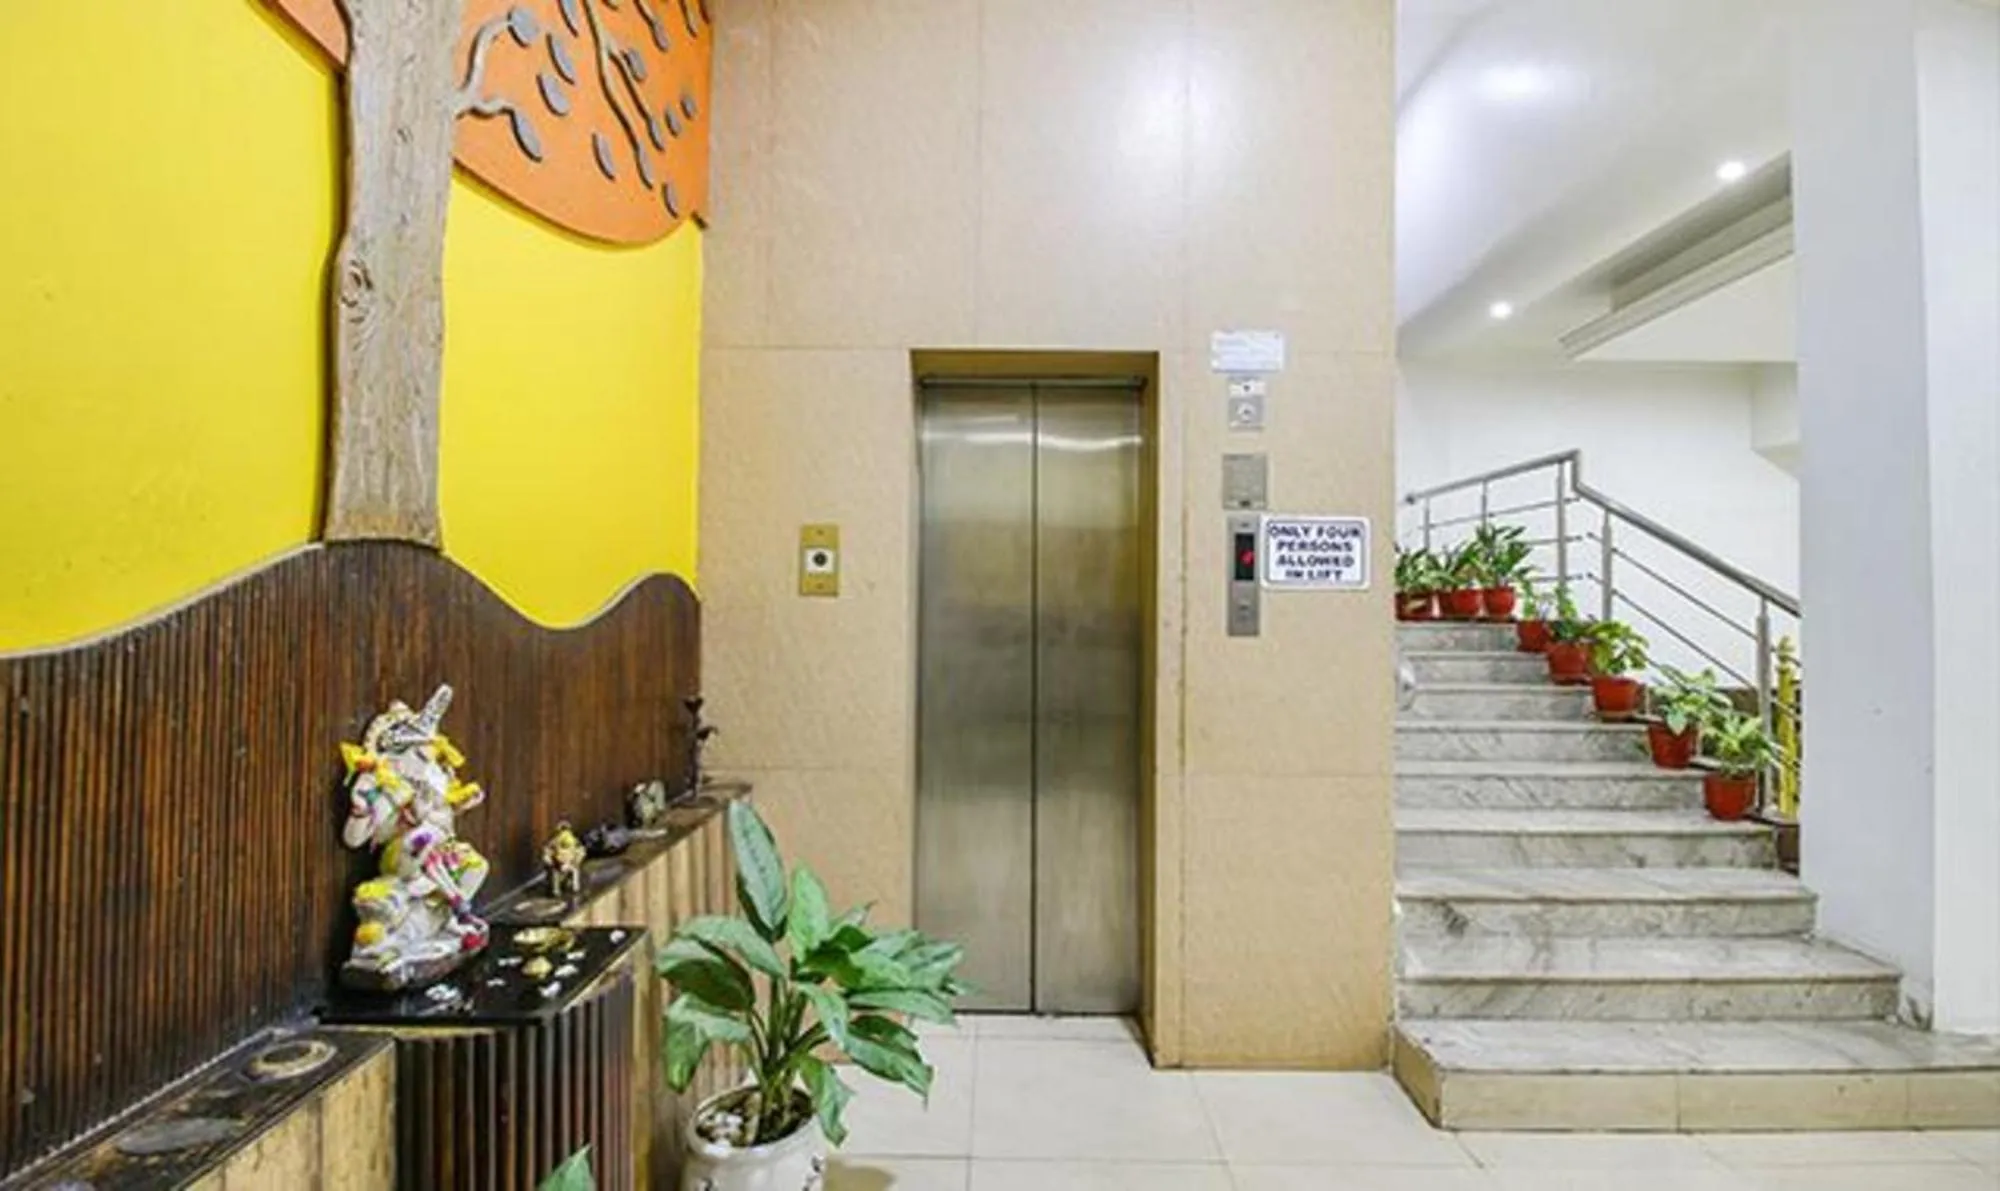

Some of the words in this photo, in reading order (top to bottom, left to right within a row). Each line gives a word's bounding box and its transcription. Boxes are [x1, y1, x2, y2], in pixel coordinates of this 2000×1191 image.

[1268, 526, 1310, 538] ONLY
[1317, 526, 1360, 538] FOUR
[1277, 541, 1352, 552] PERSONS
[1277, 555, 1355, 567] ALLOWED
[1285, 569, 1304, 579] IN
[1307, 569, 1343, 580] LIFT
